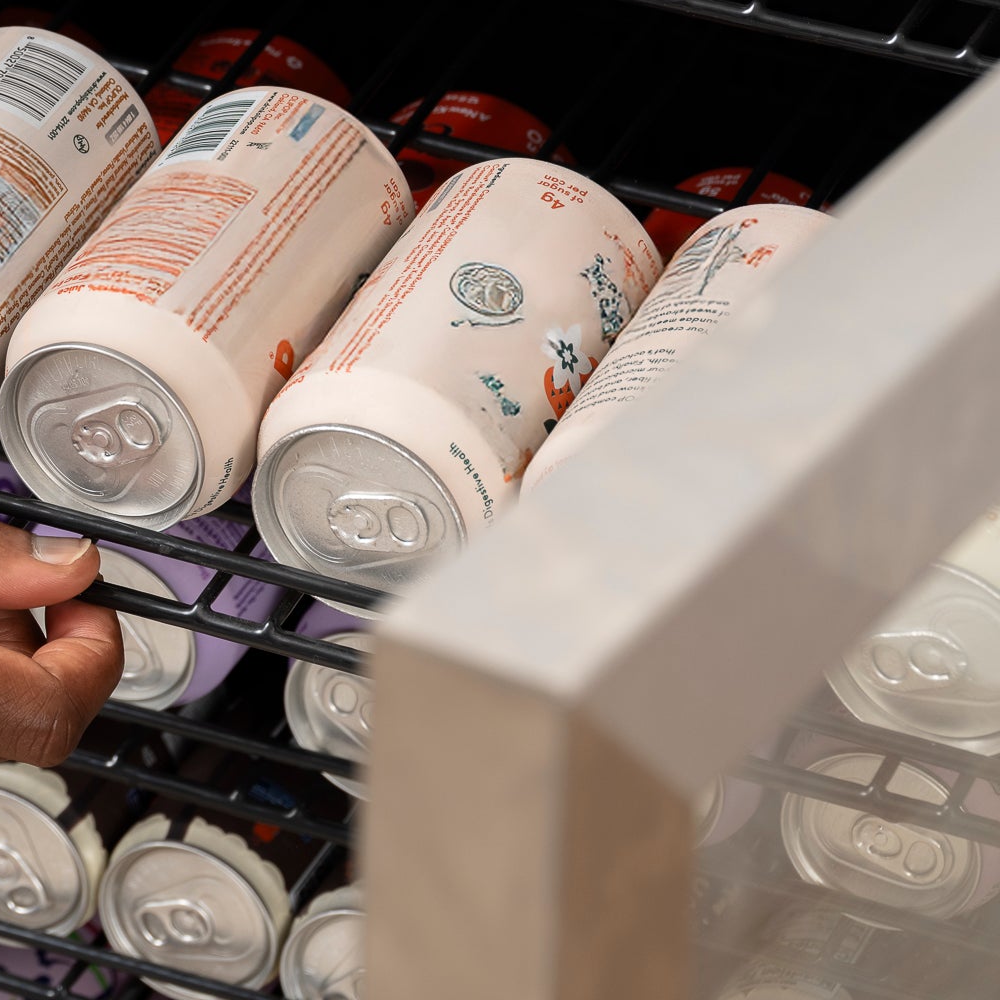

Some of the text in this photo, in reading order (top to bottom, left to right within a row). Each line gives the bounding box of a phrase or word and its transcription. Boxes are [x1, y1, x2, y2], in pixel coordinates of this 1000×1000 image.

[3, 42, 27, 70] 50027
[93, 75, 116, 101] Oakland,
[103, 83, 123, 105] OLIPOP
[46, 67, 107, 142] www.drinkolipop.com 22114-001
[87, 96, 98, 107] CA
[99, 89, 129, 125] Manufactured
[94, 120, 105, 131] for
[389, 177, 401, 199] can
[537, 180, 584, 204] of sugar
[544, 174, 589, 197] per can
[384, 183, 399, 213] sugar
[541, 191, 566, 210] 4g
[381, 201, 392, 225] 4g
[57, 284, 85, 296] Juice
[690, 307, 717, 317] sweet
[652, 346, 676, 357] that's
[220, 456, 235, 492] Health
[449, 442, 496, 521] Digestive Health
